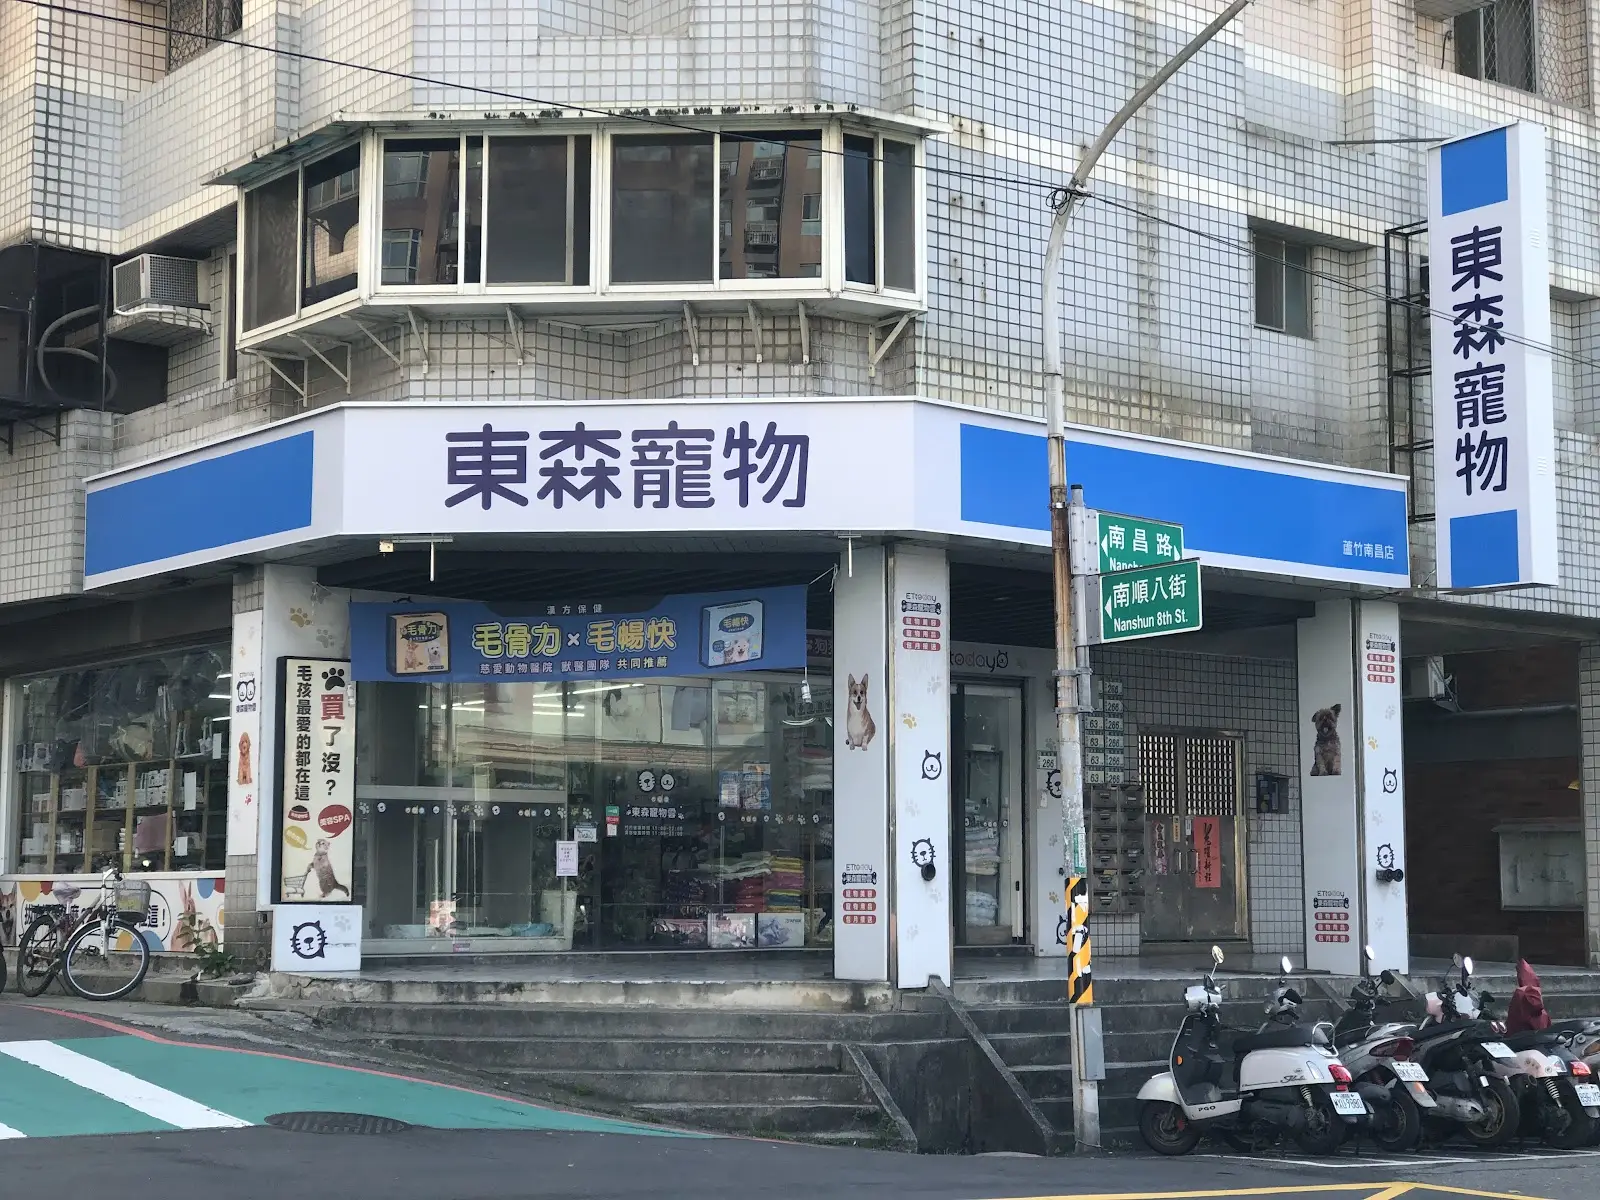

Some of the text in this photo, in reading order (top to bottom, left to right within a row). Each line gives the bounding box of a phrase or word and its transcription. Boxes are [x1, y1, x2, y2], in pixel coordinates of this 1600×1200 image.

[1451, 225, 1508, 496] 東森寵物
[445, 420, 810, 510] 東森寵物
[1108, 525, 1173, 557] 南昌路
[1342, 540, 1394, 560] 蘆竹南昌店
[1113, 573, 1187, 609] 南順八街
[546, 603, 603, 615] 漢方保健
[1114, 608, 1189, 632] Nanshun 8th St.
[472, 622, 561, 658] 毛骨力
[586, 616, 677, 653] 毛暢快
[480, 656, 668, 675] 慈愛動物醫院 獸醫團隊 共同推薦
[295, 665, 312, 801] 毛孩最愛的都在這
